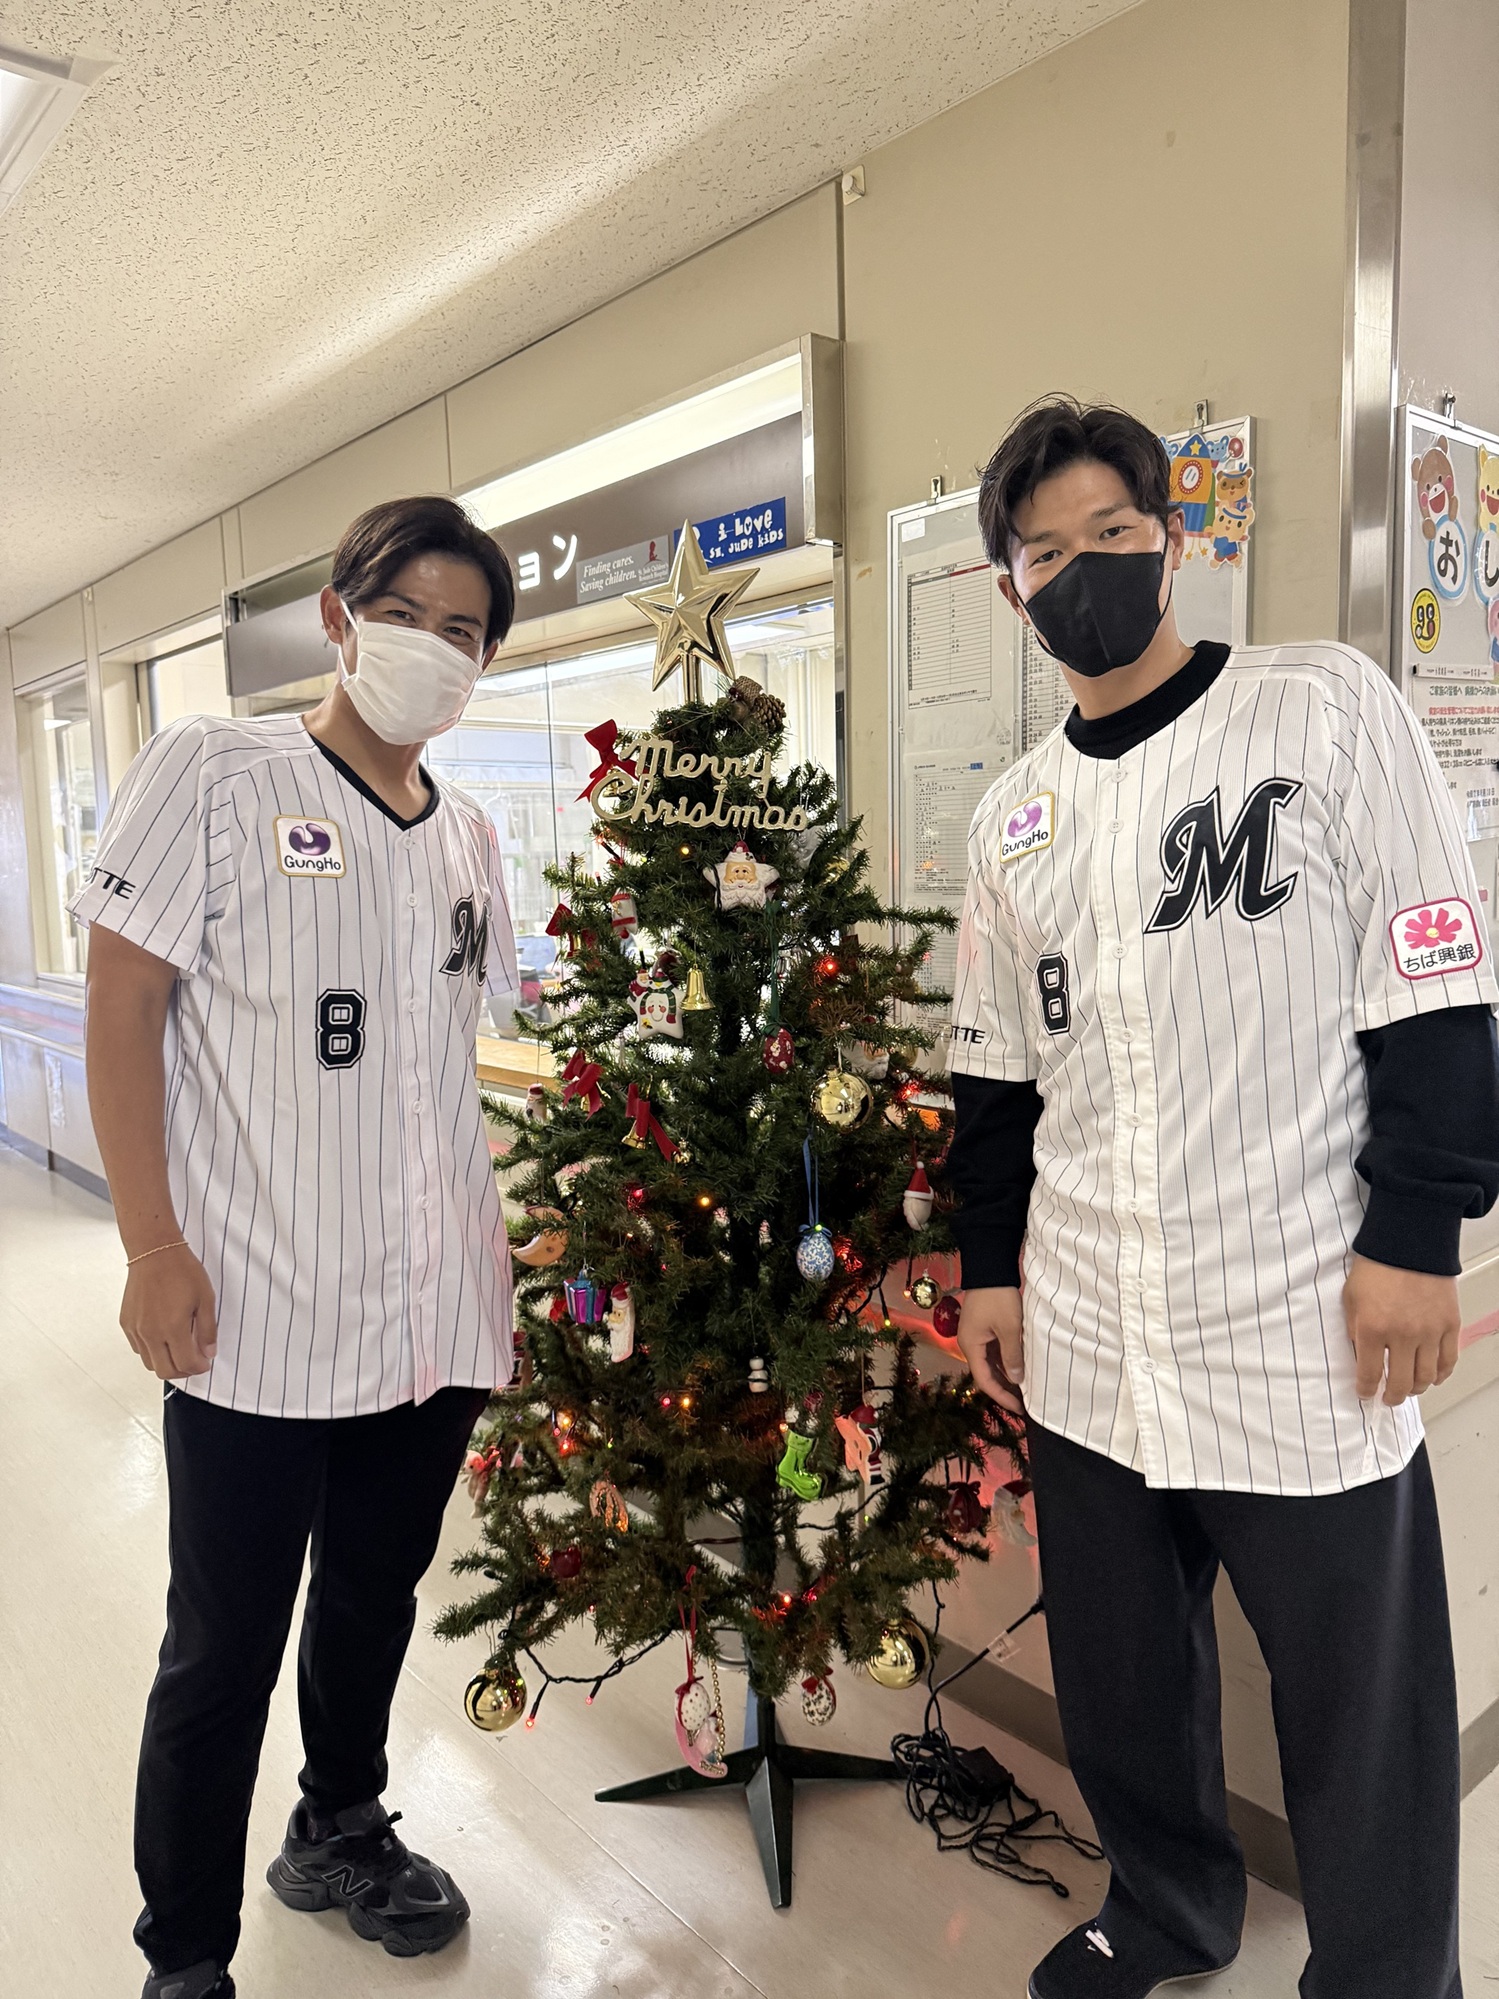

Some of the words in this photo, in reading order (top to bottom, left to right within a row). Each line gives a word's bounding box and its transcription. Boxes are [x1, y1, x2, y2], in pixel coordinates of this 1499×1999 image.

[580, 577, 604, 594] Saving
[605, 569, 637, 587] children.
[583, 561, 611, 578] Finding
[612, 555, 634, 570] cures.
[617, 737, 772, 799] Merry
[590, 771, 808, 832] Christmas
[1001, 829, 1050, 857] GungHo
[1144, 777, 1303, 934] M
[284, 853, 342, 873] GungHo
[1403, 943, 1477, 973] ちば興銀
[1034, 951, 1072, 1036] 8
[315, 988, 367, 1071] 8
[950, 1025, 986, 1044] TTE
